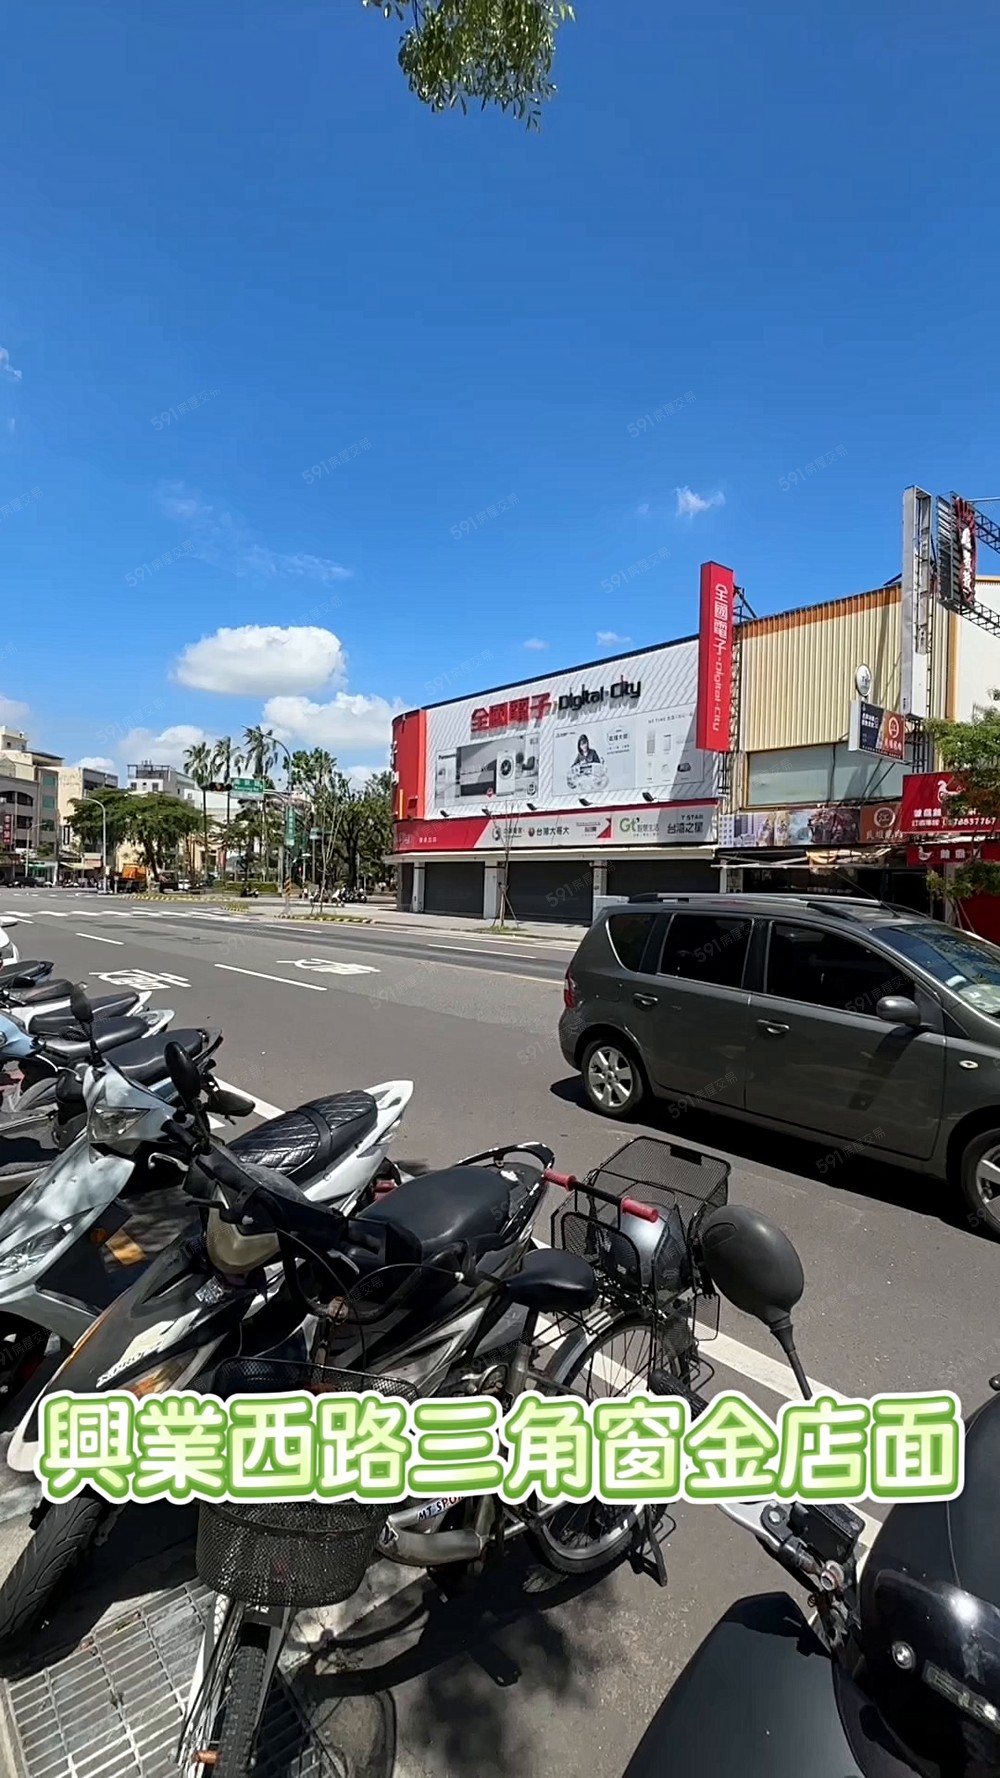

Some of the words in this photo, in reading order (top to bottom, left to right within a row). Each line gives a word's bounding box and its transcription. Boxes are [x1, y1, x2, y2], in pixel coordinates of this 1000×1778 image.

[713, 583, 729, 655] 全國電子
[471, 692, 552, 731] 全國電子
